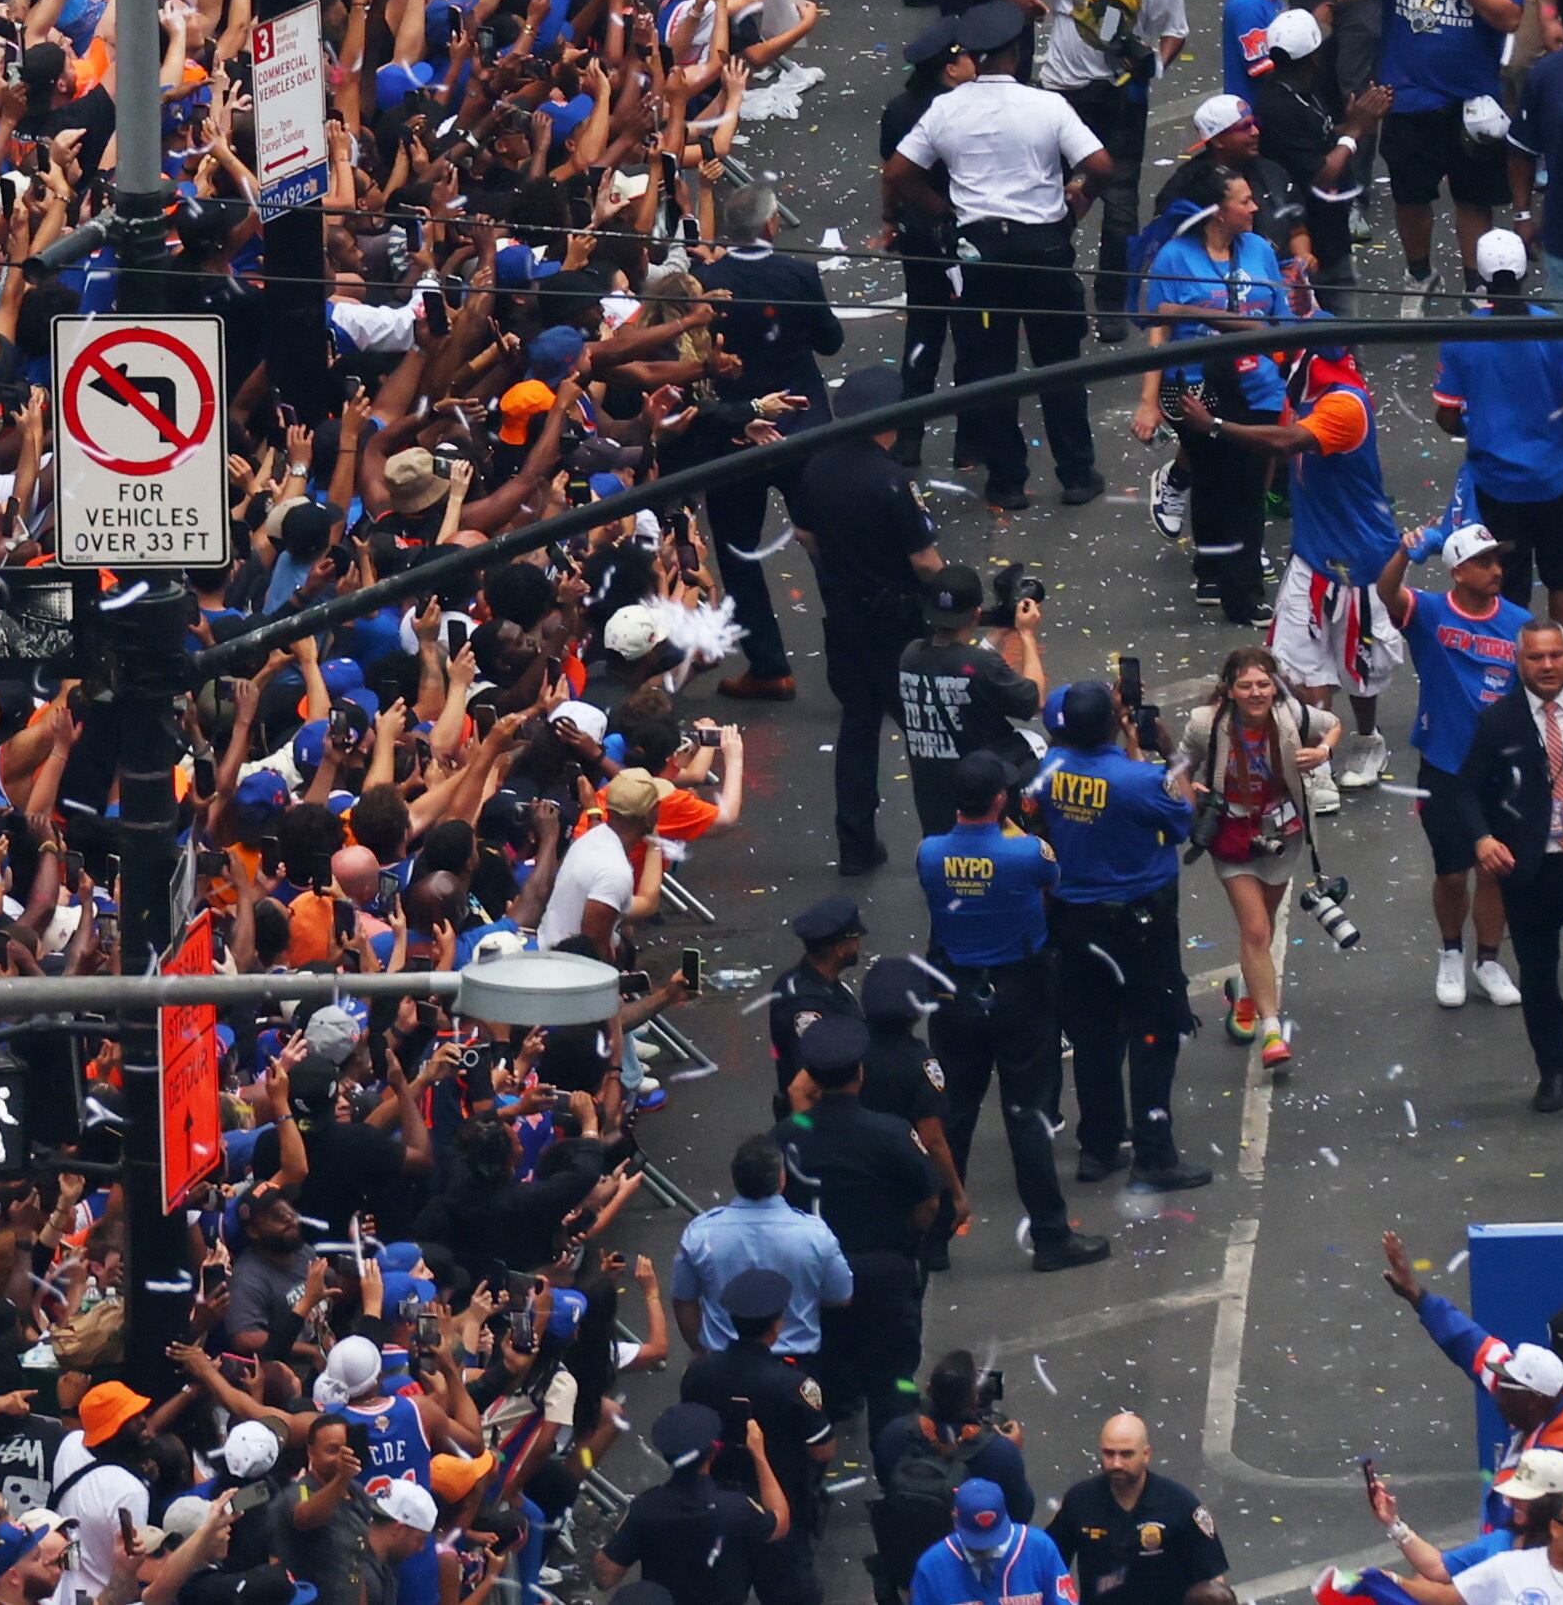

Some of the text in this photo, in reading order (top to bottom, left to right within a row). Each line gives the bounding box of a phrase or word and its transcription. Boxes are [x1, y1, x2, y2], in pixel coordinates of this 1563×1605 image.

[258, 27, 270, 60] 3
[257, 54, 309, 87] COMMERCIAL
[259, 65, 317, 103] VEHICLES ONLY
[119, 483, 163, 503] FOR
[85, 508, 200, 528] VEHICLES
[74, 532, 210, 553] OVER 33 FT
[1051, 770, 1109, 810] NYPD
[943, 856, 994, 879] NYPD
[168, 1049, 209, 1107] DETOUR
